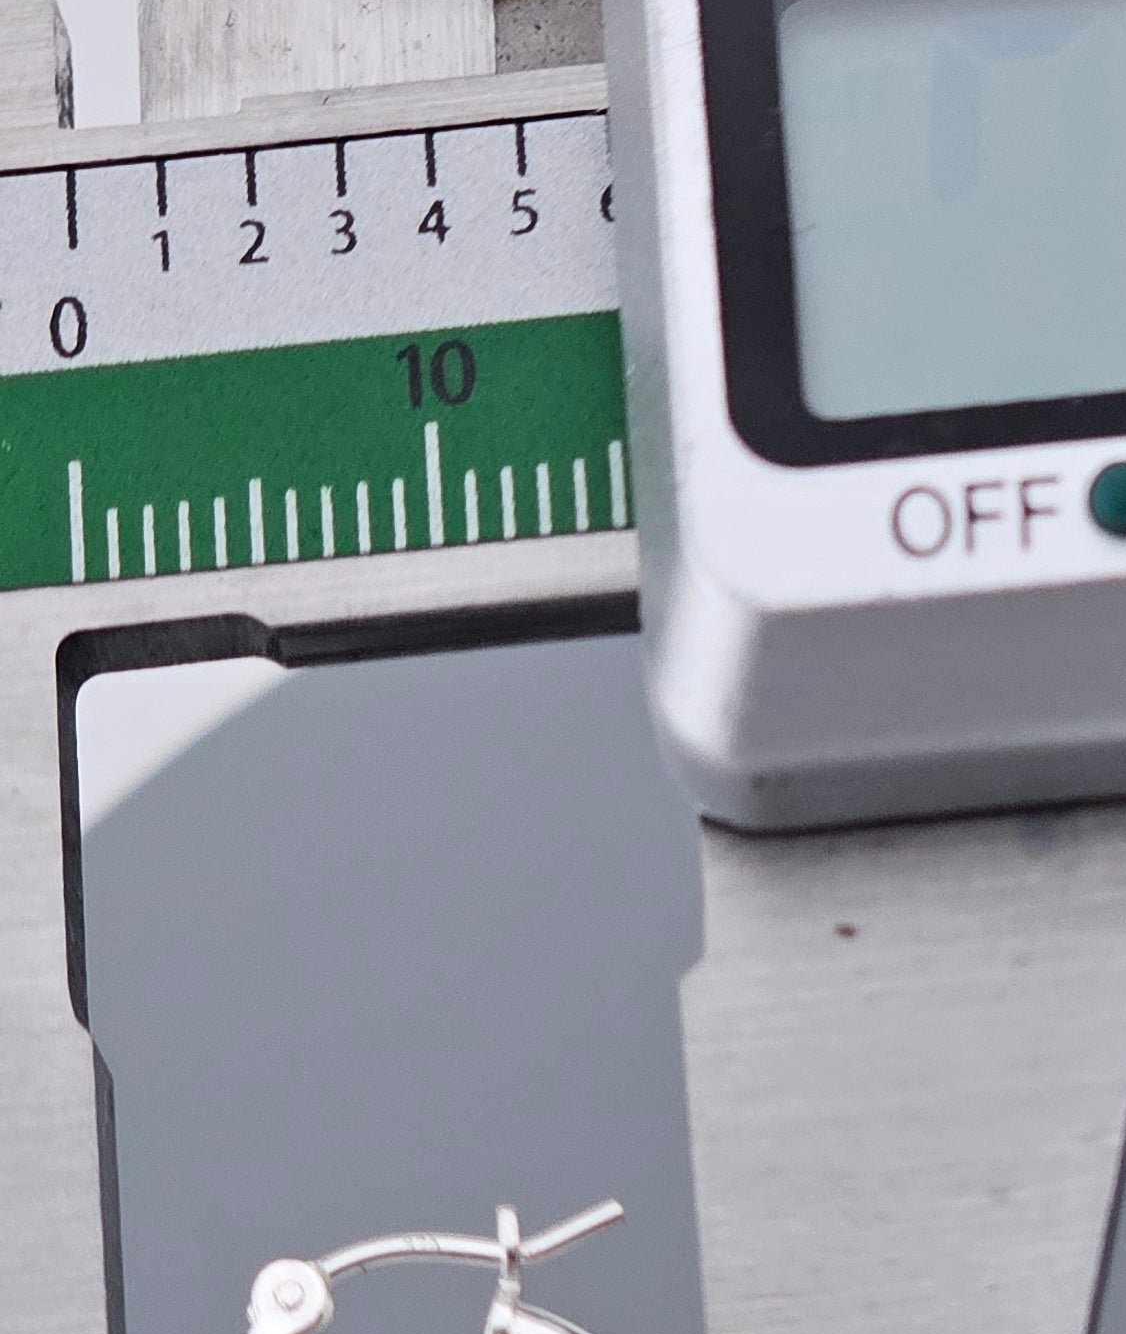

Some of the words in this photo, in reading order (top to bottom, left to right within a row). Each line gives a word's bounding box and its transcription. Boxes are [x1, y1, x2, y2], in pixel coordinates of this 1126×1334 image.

[152, 230, 170, 272] 1
[239, 220, 270, 265] 2
[330, 210, 358, 255] 3
[418, 200, 451, 245] 4
[511, 189, 539, 235] 5
[50, 297, 88, 358] 0
[396, 340, 476, 408] 10
[890, 475, 1061, 560] OFF
